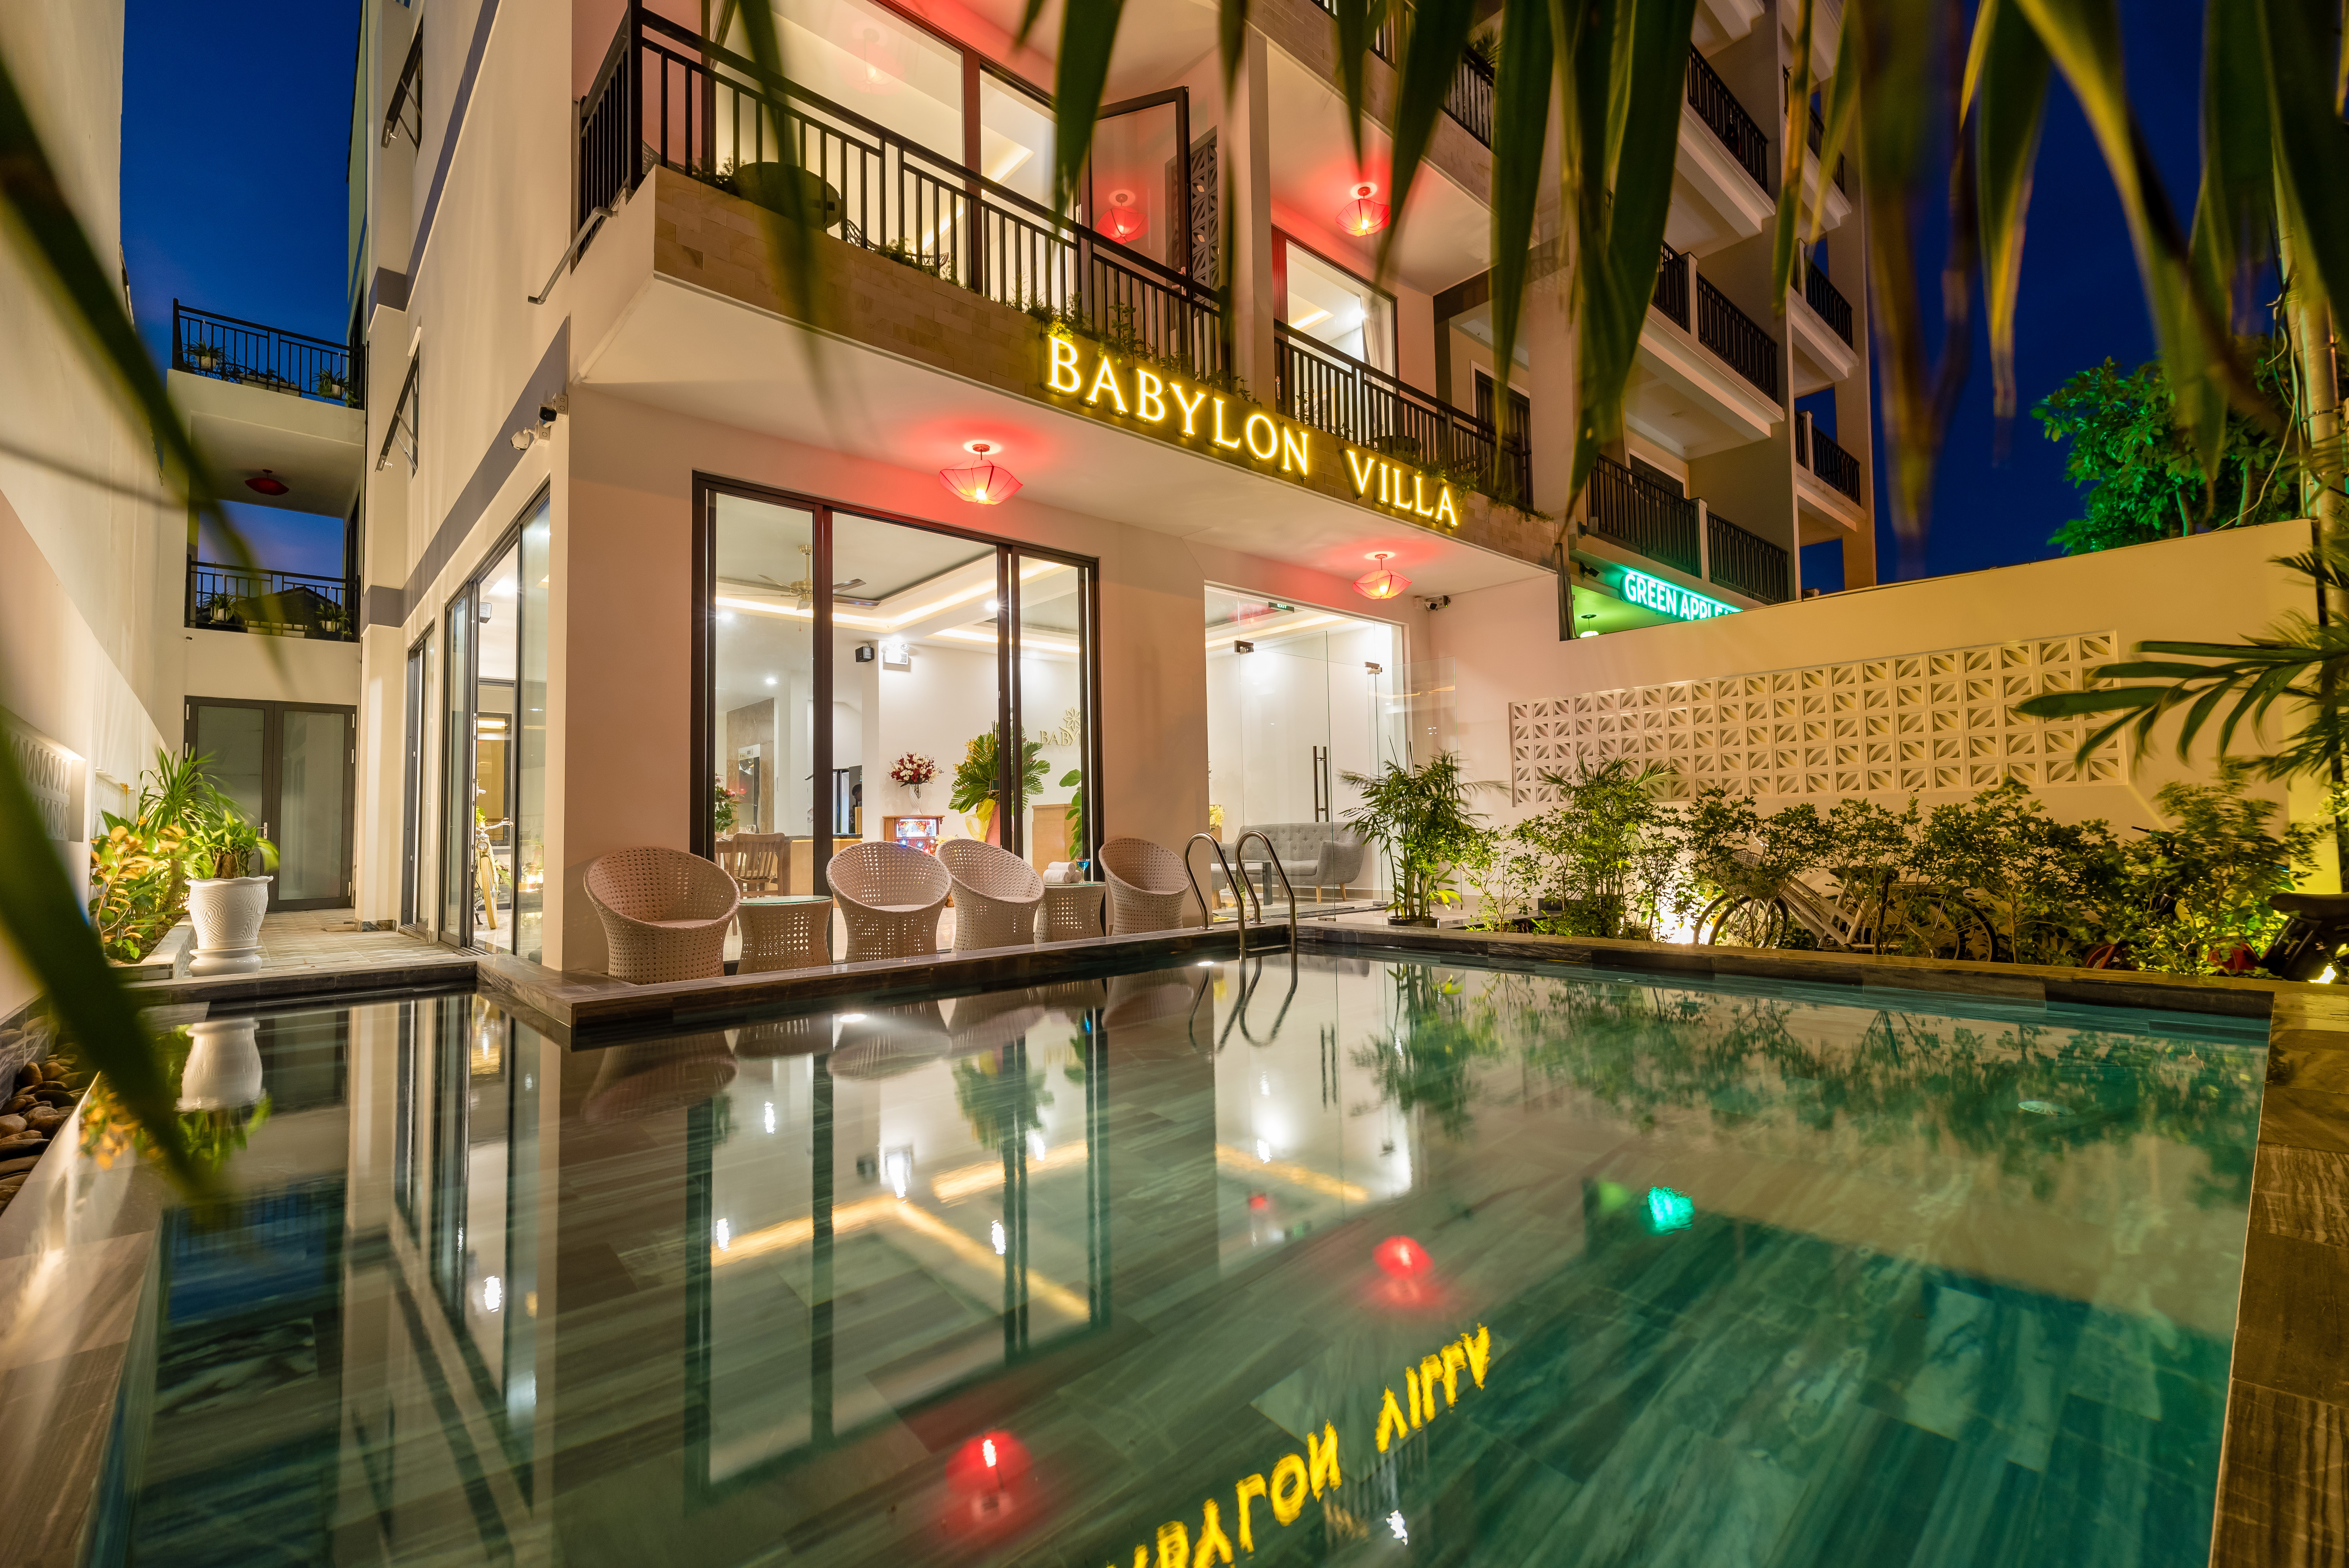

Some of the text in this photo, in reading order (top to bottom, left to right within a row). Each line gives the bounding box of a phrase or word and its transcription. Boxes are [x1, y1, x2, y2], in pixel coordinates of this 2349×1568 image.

[1046, 334, 1459, 528] BABYLON VILLA
[1624, 573, 1677, 616] GREEN
[1040, 726, 1080, 746] BABY
